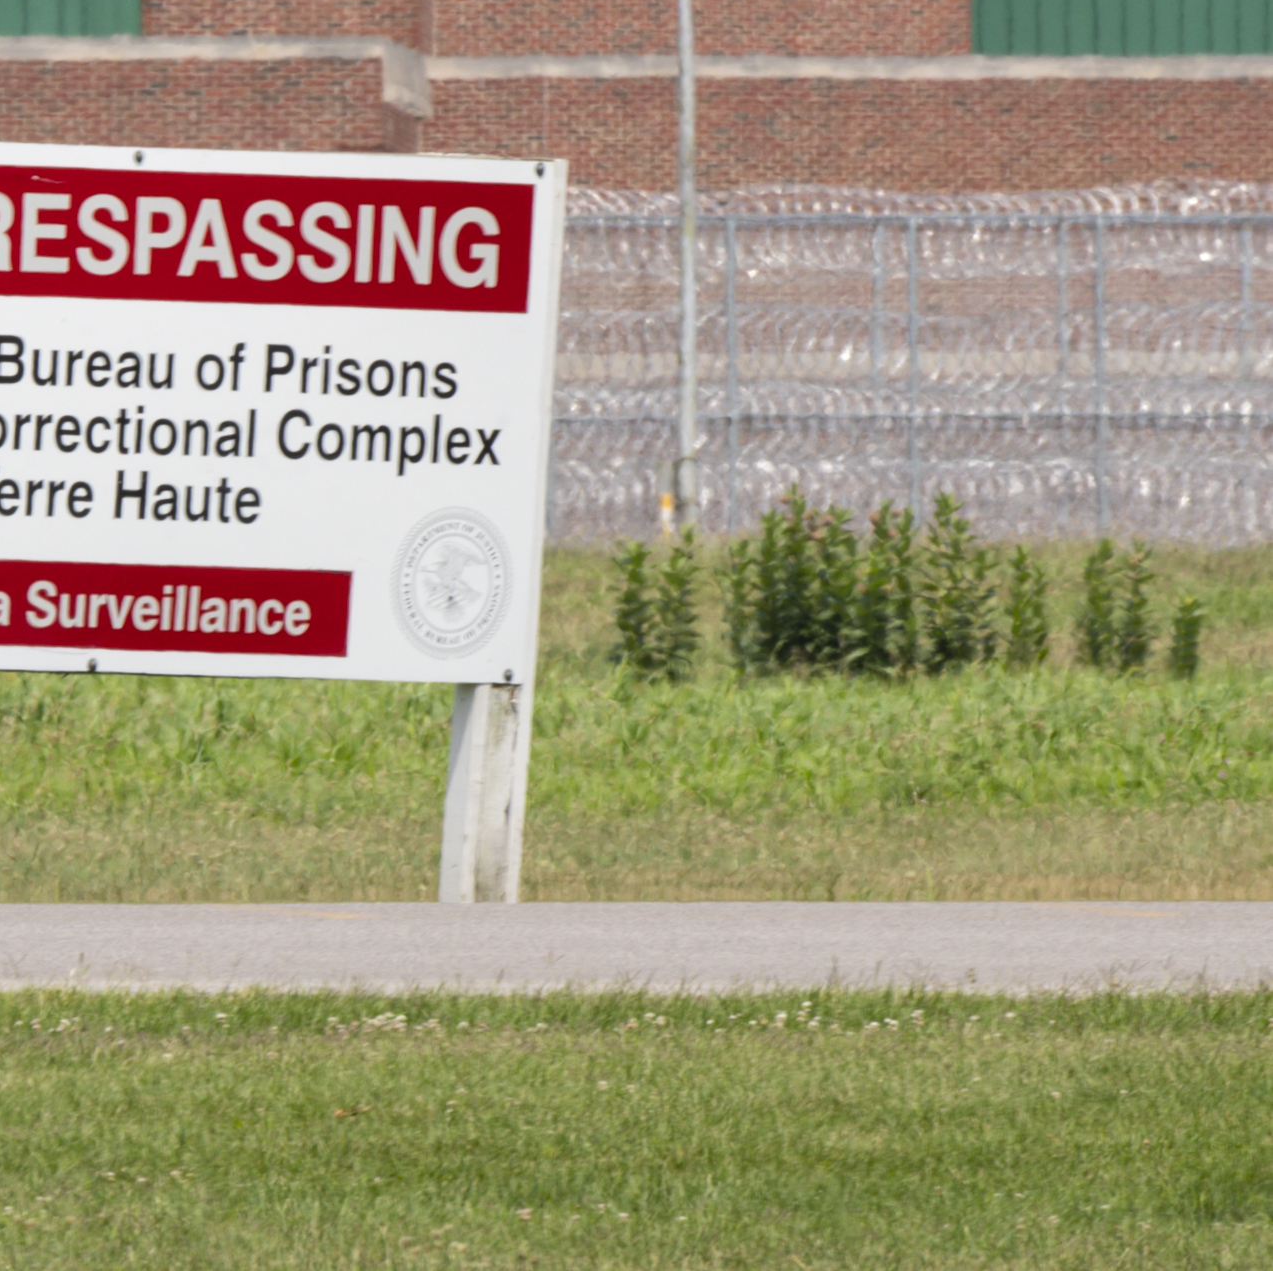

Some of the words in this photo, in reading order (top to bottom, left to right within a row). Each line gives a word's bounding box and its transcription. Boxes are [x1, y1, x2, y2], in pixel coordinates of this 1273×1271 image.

[196, 342, 245, 391] of
[265, 344, 457, 399] Prisons
[278, 409, 500, 476] Complex
[114, 470, 260, 524] Haute
[25, 580, 311, 636] Surveillance
